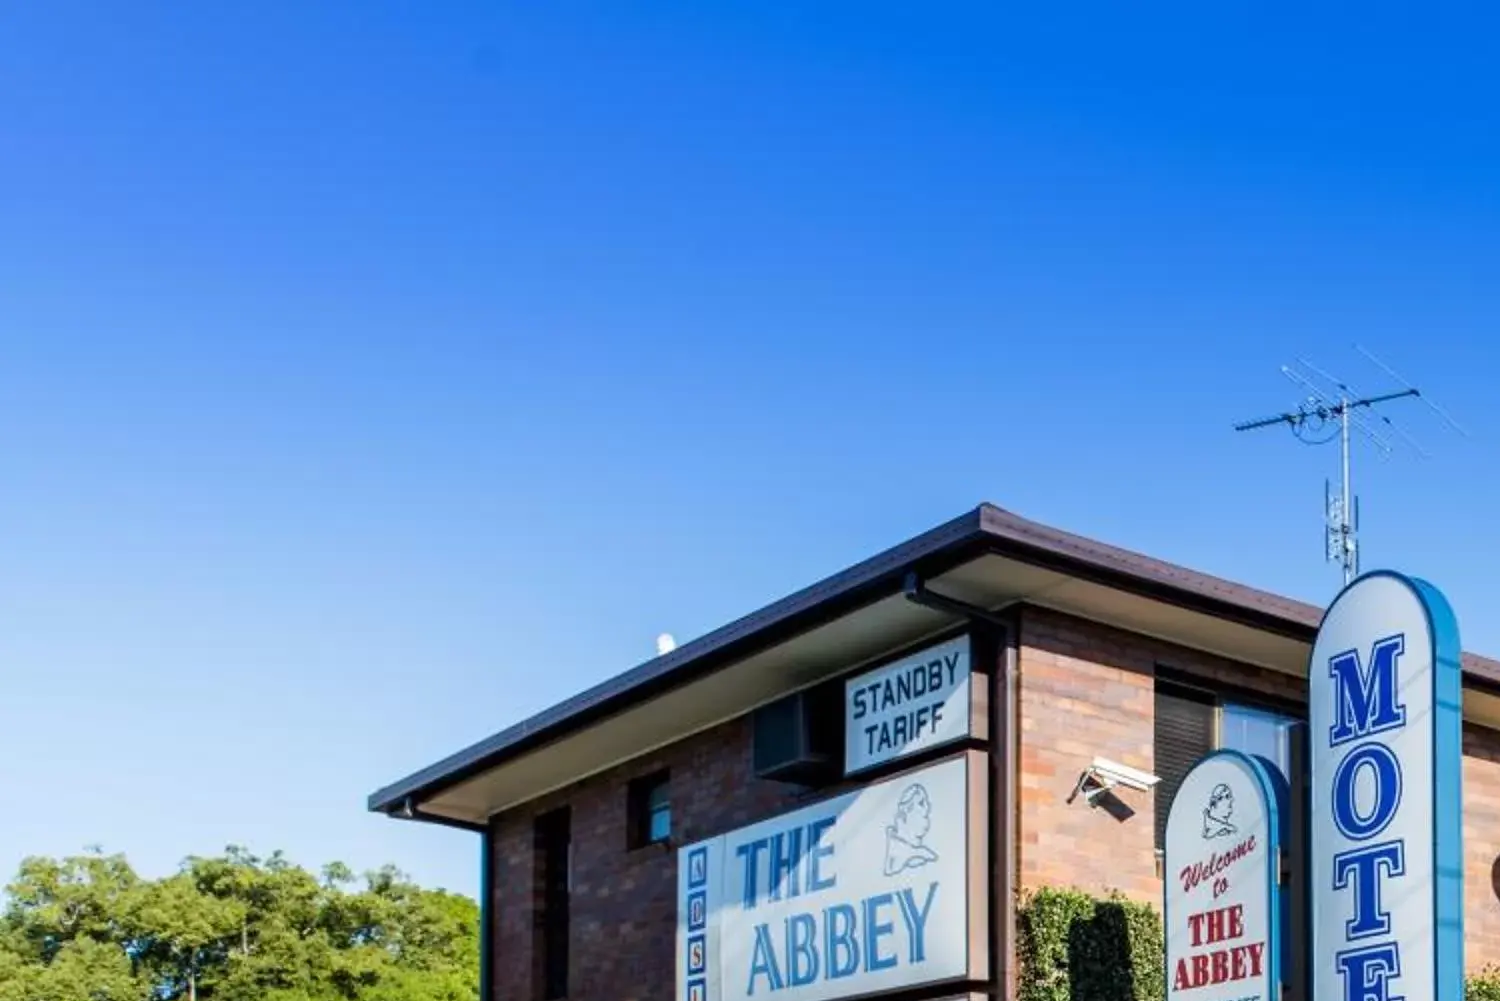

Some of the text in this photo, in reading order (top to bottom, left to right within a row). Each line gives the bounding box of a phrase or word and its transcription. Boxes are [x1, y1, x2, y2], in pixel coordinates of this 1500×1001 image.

[853, 652, 960, 719] STANDBY
[865, 702, 945, 755] TARIFF
[737, 816, 837, 909] THE
[1179, 835, 1256, 893] Welcome
[1213, 876, 1228, 899] to
[747, 881, 939, 996] ABBEY
[1188, 904, 1243, 947] THE
[1173, 943, 1265, 992] ABBEY
